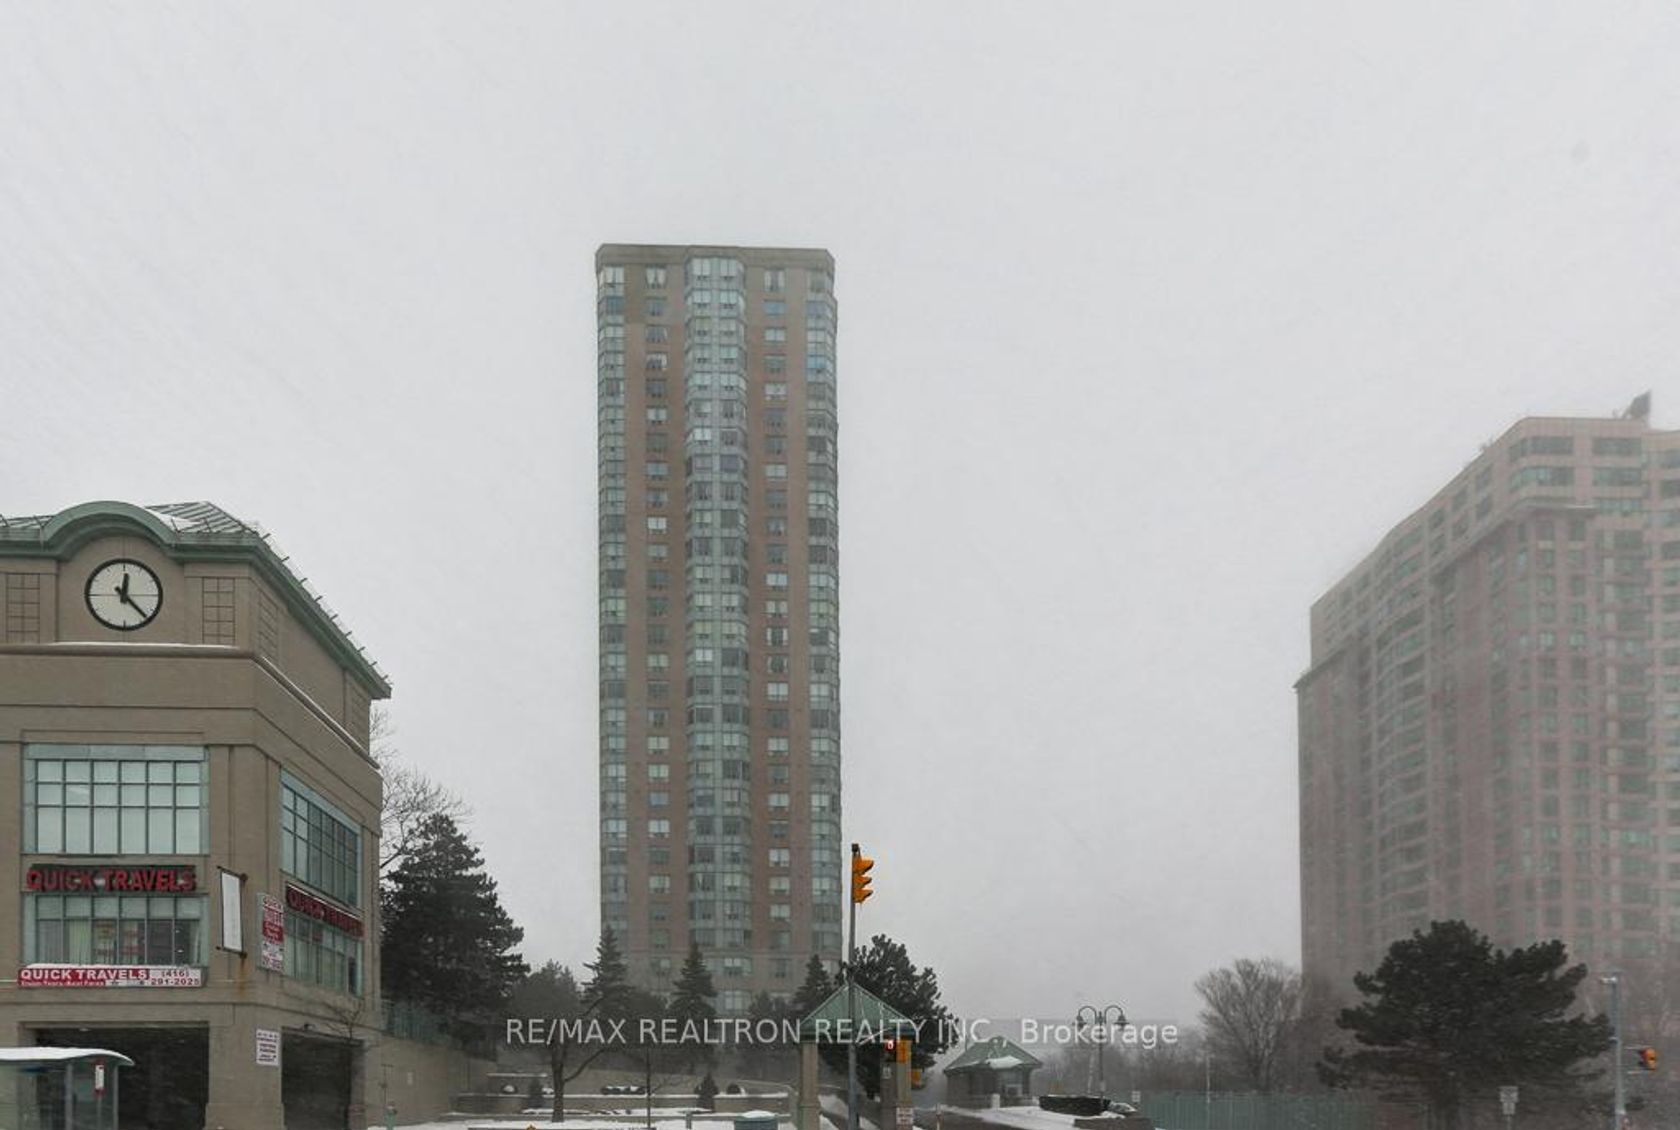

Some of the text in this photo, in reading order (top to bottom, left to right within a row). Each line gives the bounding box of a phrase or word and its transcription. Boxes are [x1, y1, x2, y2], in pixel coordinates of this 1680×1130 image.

[26, 867, 197, 892] QUICK TRAVELS
[20, 969, 148, 980] QUICK TRAVELS
[161, 968, 190, 978] (416)
[151, 977, 200, 986] 291-2025
